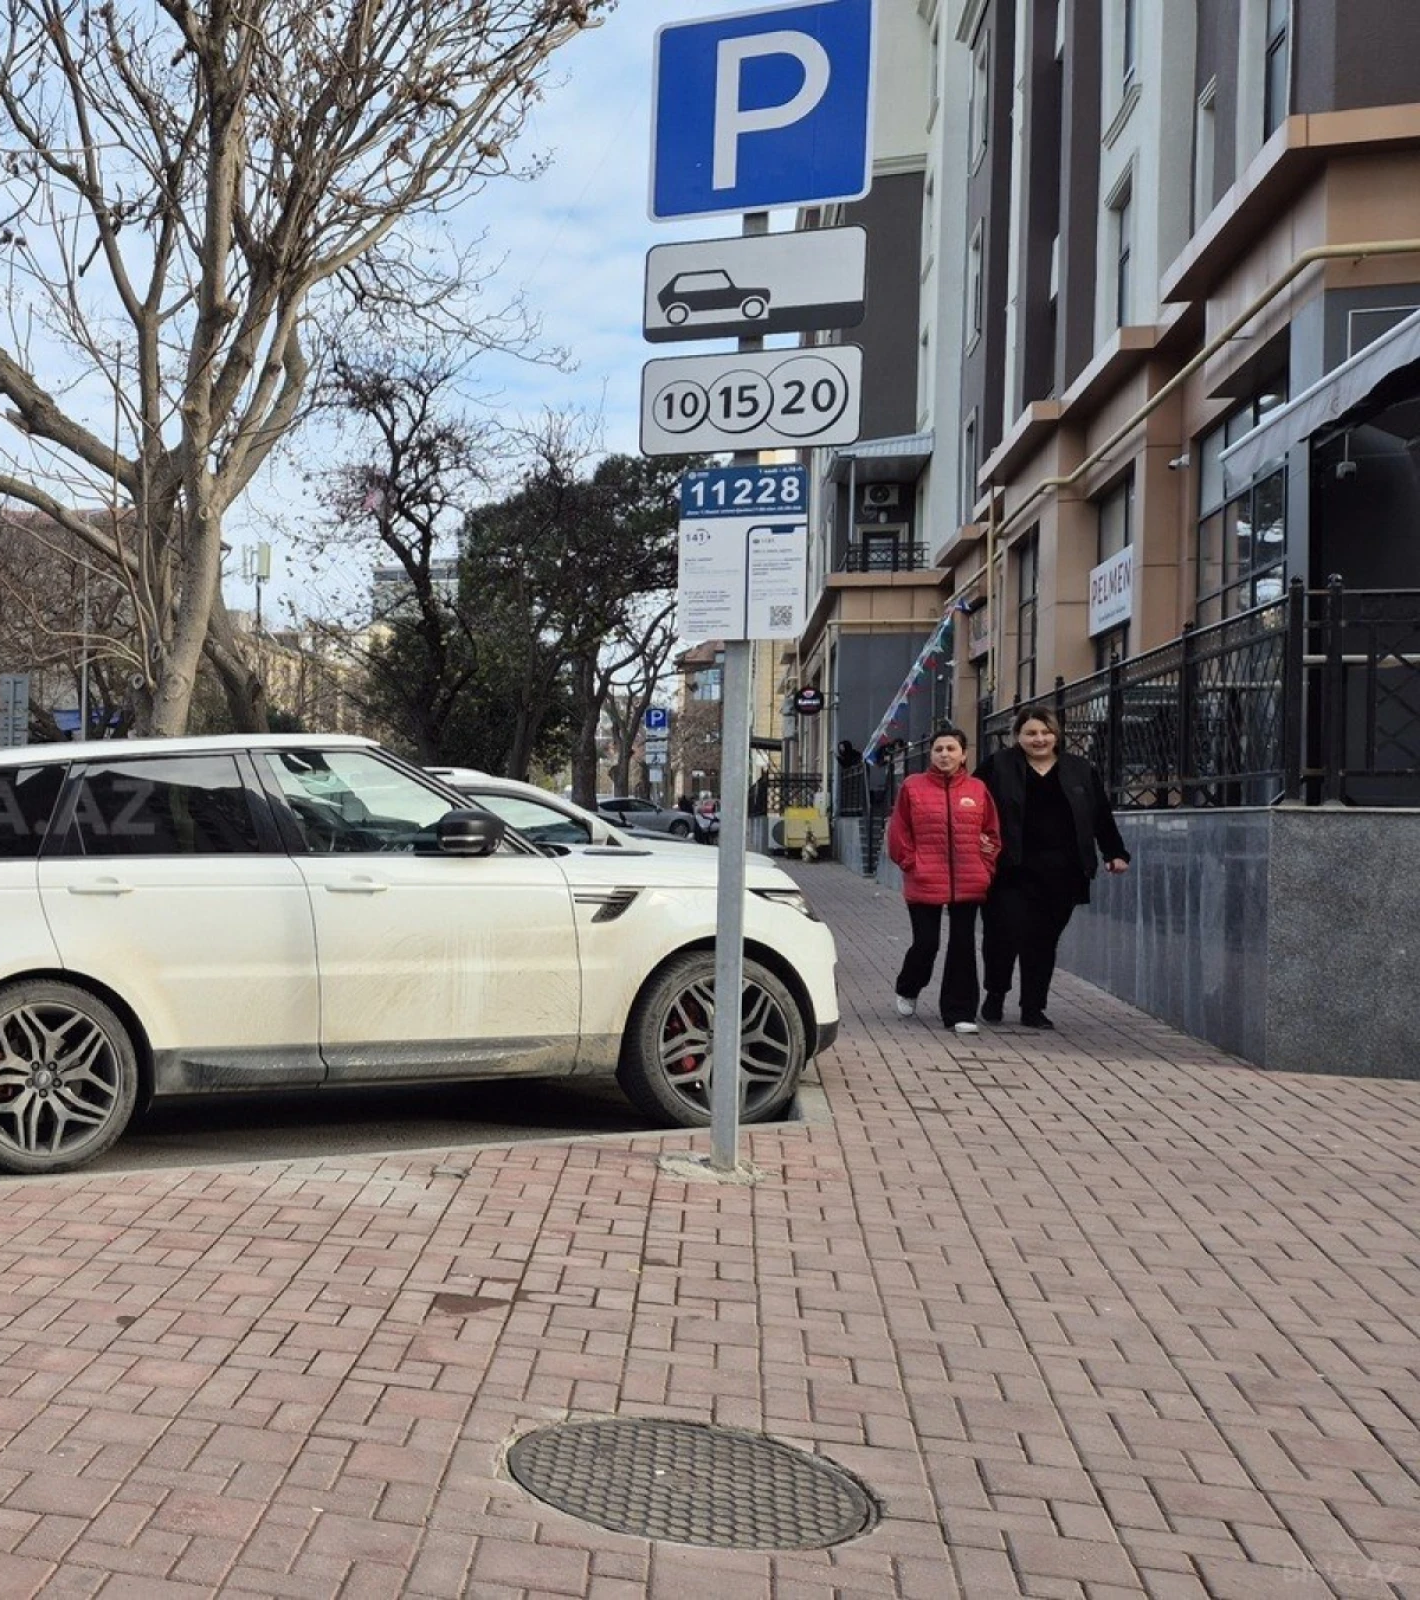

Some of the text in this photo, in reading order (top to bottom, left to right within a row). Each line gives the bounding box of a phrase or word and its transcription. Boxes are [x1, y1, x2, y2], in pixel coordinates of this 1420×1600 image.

[712, 30, 830, 191] P
[663, 391, 699, 420] 10
[718, 385, 760, 419] 15
[780, 378, 837, 415] 20
[690, 475, 800, 507] 11228
[1091, 557, 1132, 608] PELMEN
[651, 710, 664, 726] P
